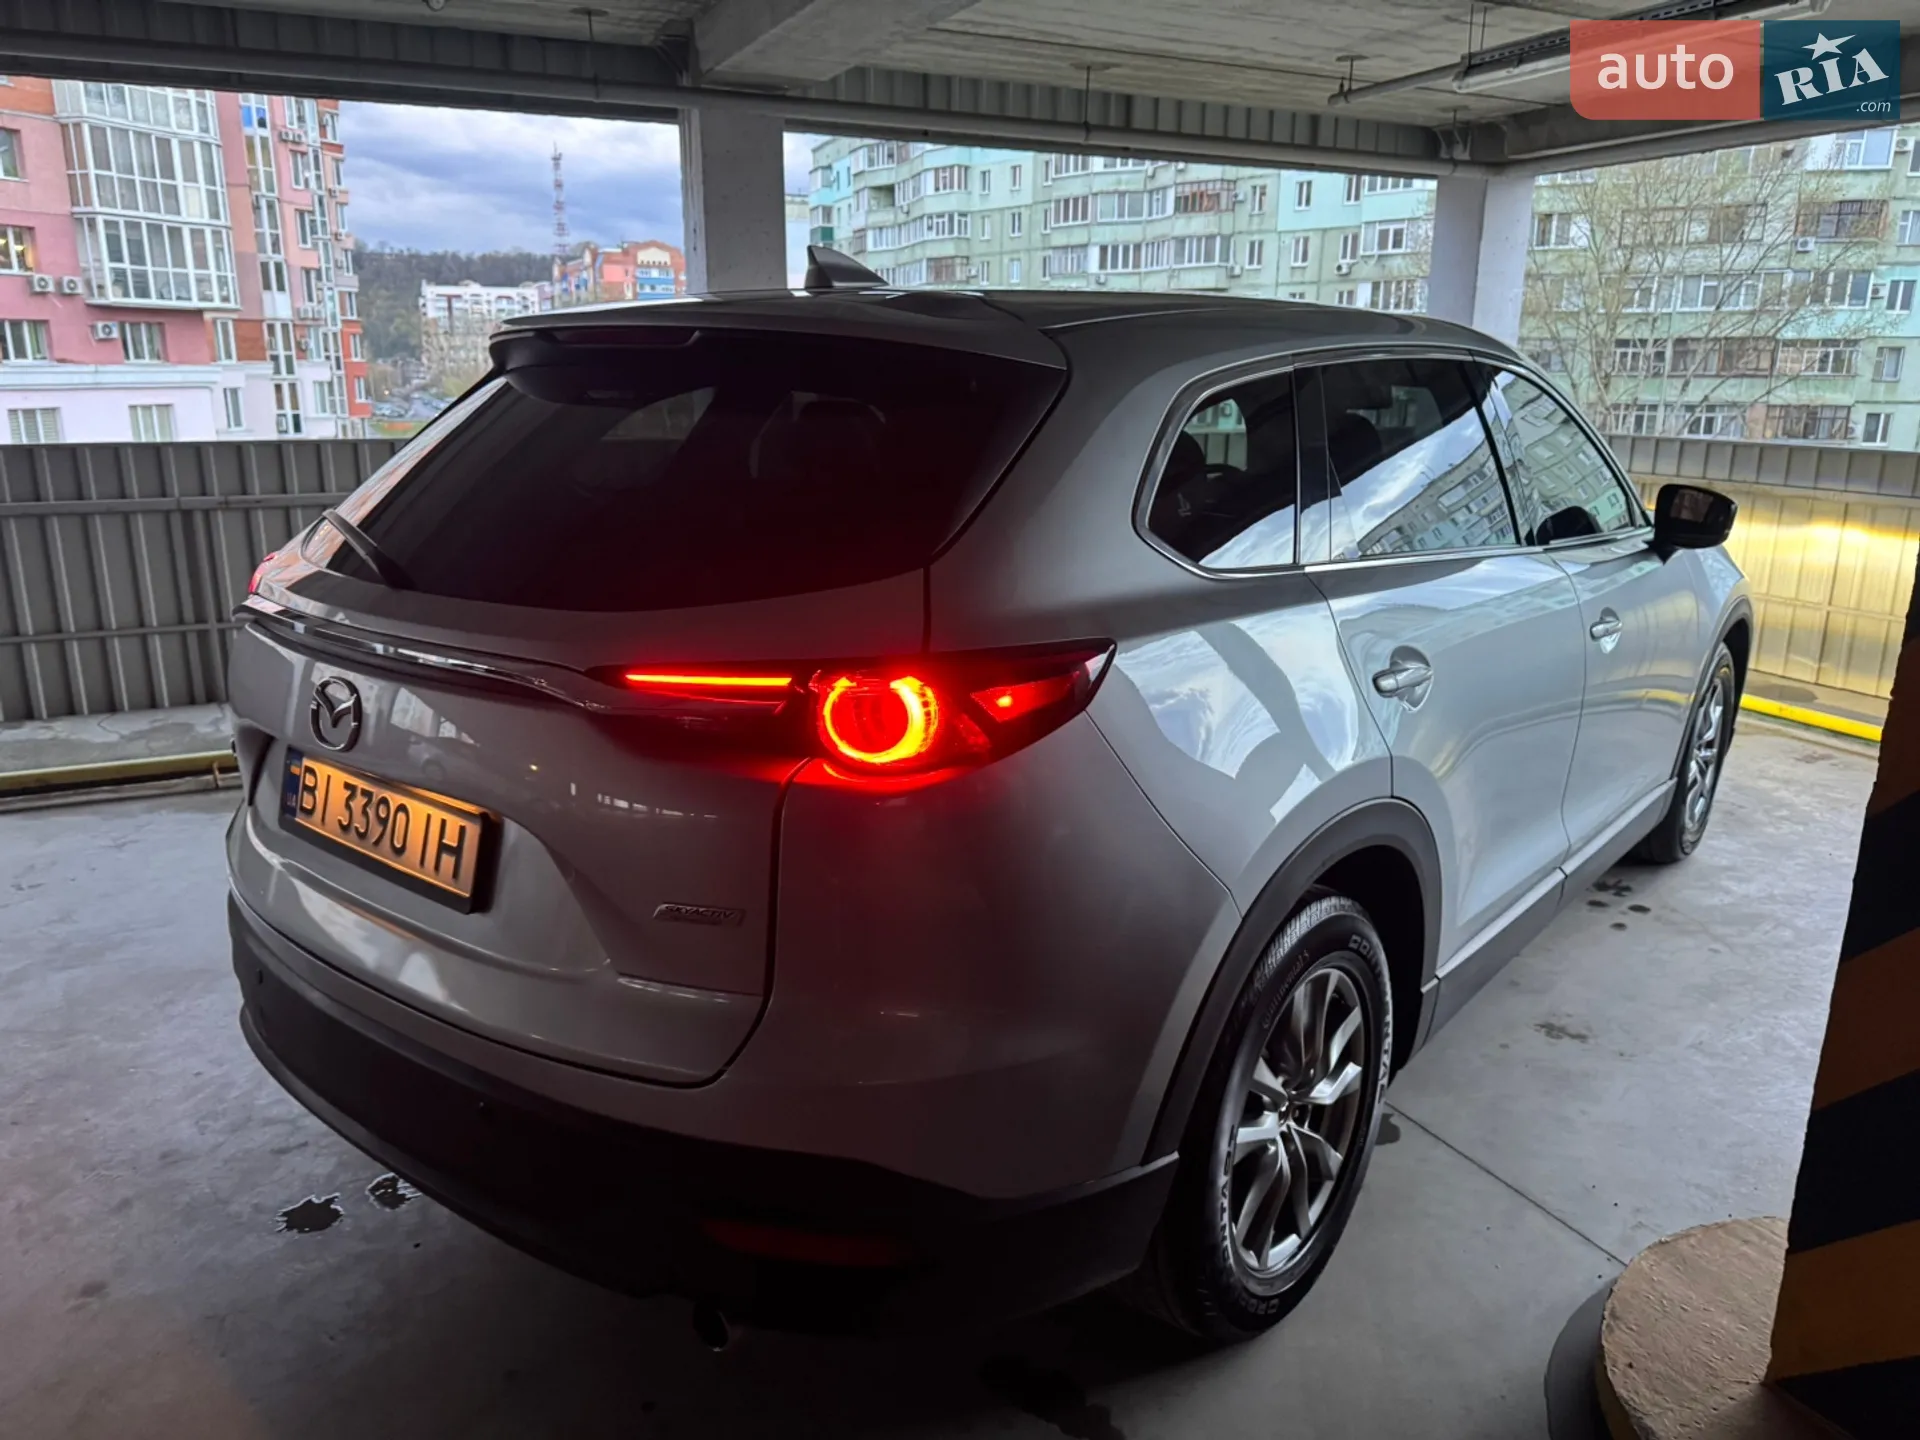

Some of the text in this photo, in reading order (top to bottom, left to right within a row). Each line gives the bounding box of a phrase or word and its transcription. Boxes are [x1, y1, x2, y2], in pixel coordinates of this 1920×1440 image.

[299, 764, 467, 880] BI 3390 IH
